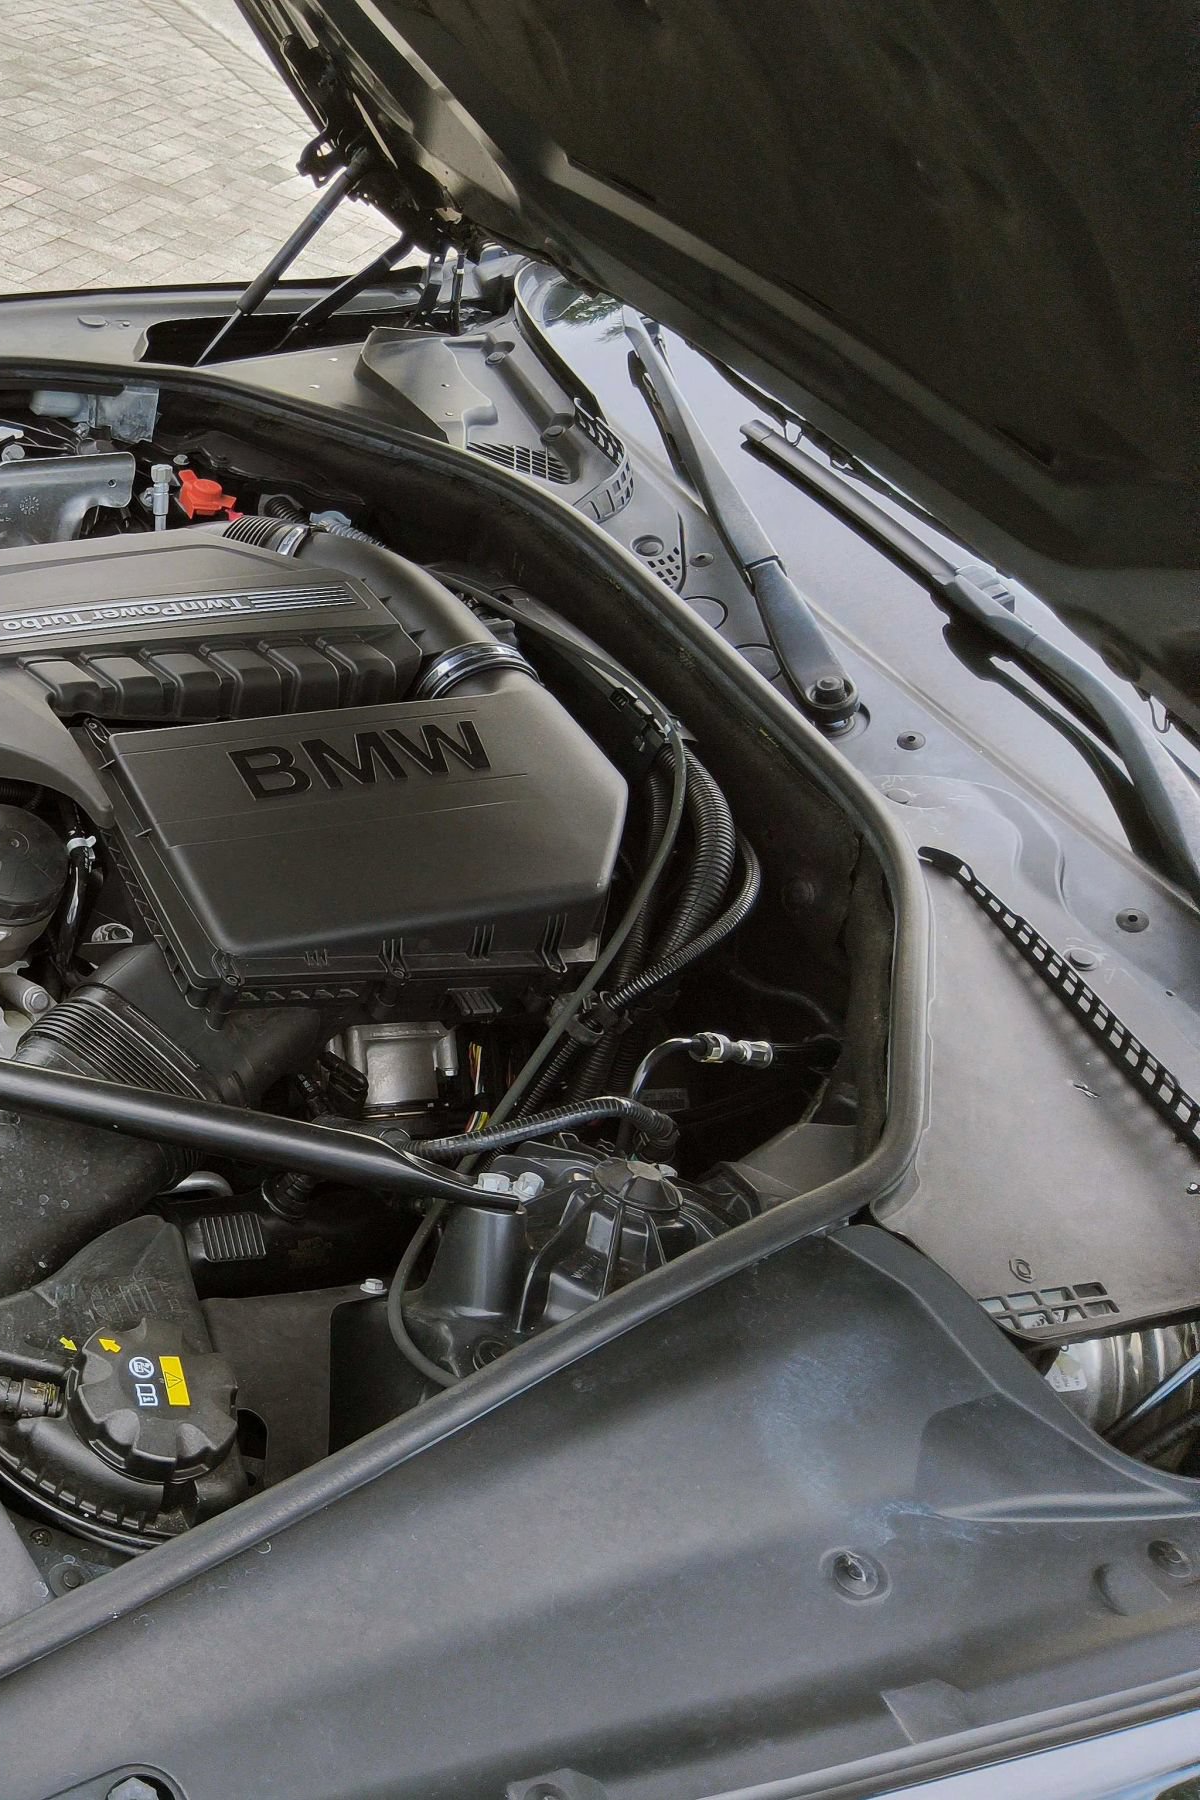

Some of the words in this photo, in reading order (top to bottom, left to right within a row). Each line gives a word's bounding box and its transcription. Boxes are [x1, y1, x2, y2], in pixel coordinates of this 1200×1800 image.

[92, 596, 250, 620] TwinPower
[2, 613, 92, 631] Turbo
[226, 720, 492, 801] BMW
